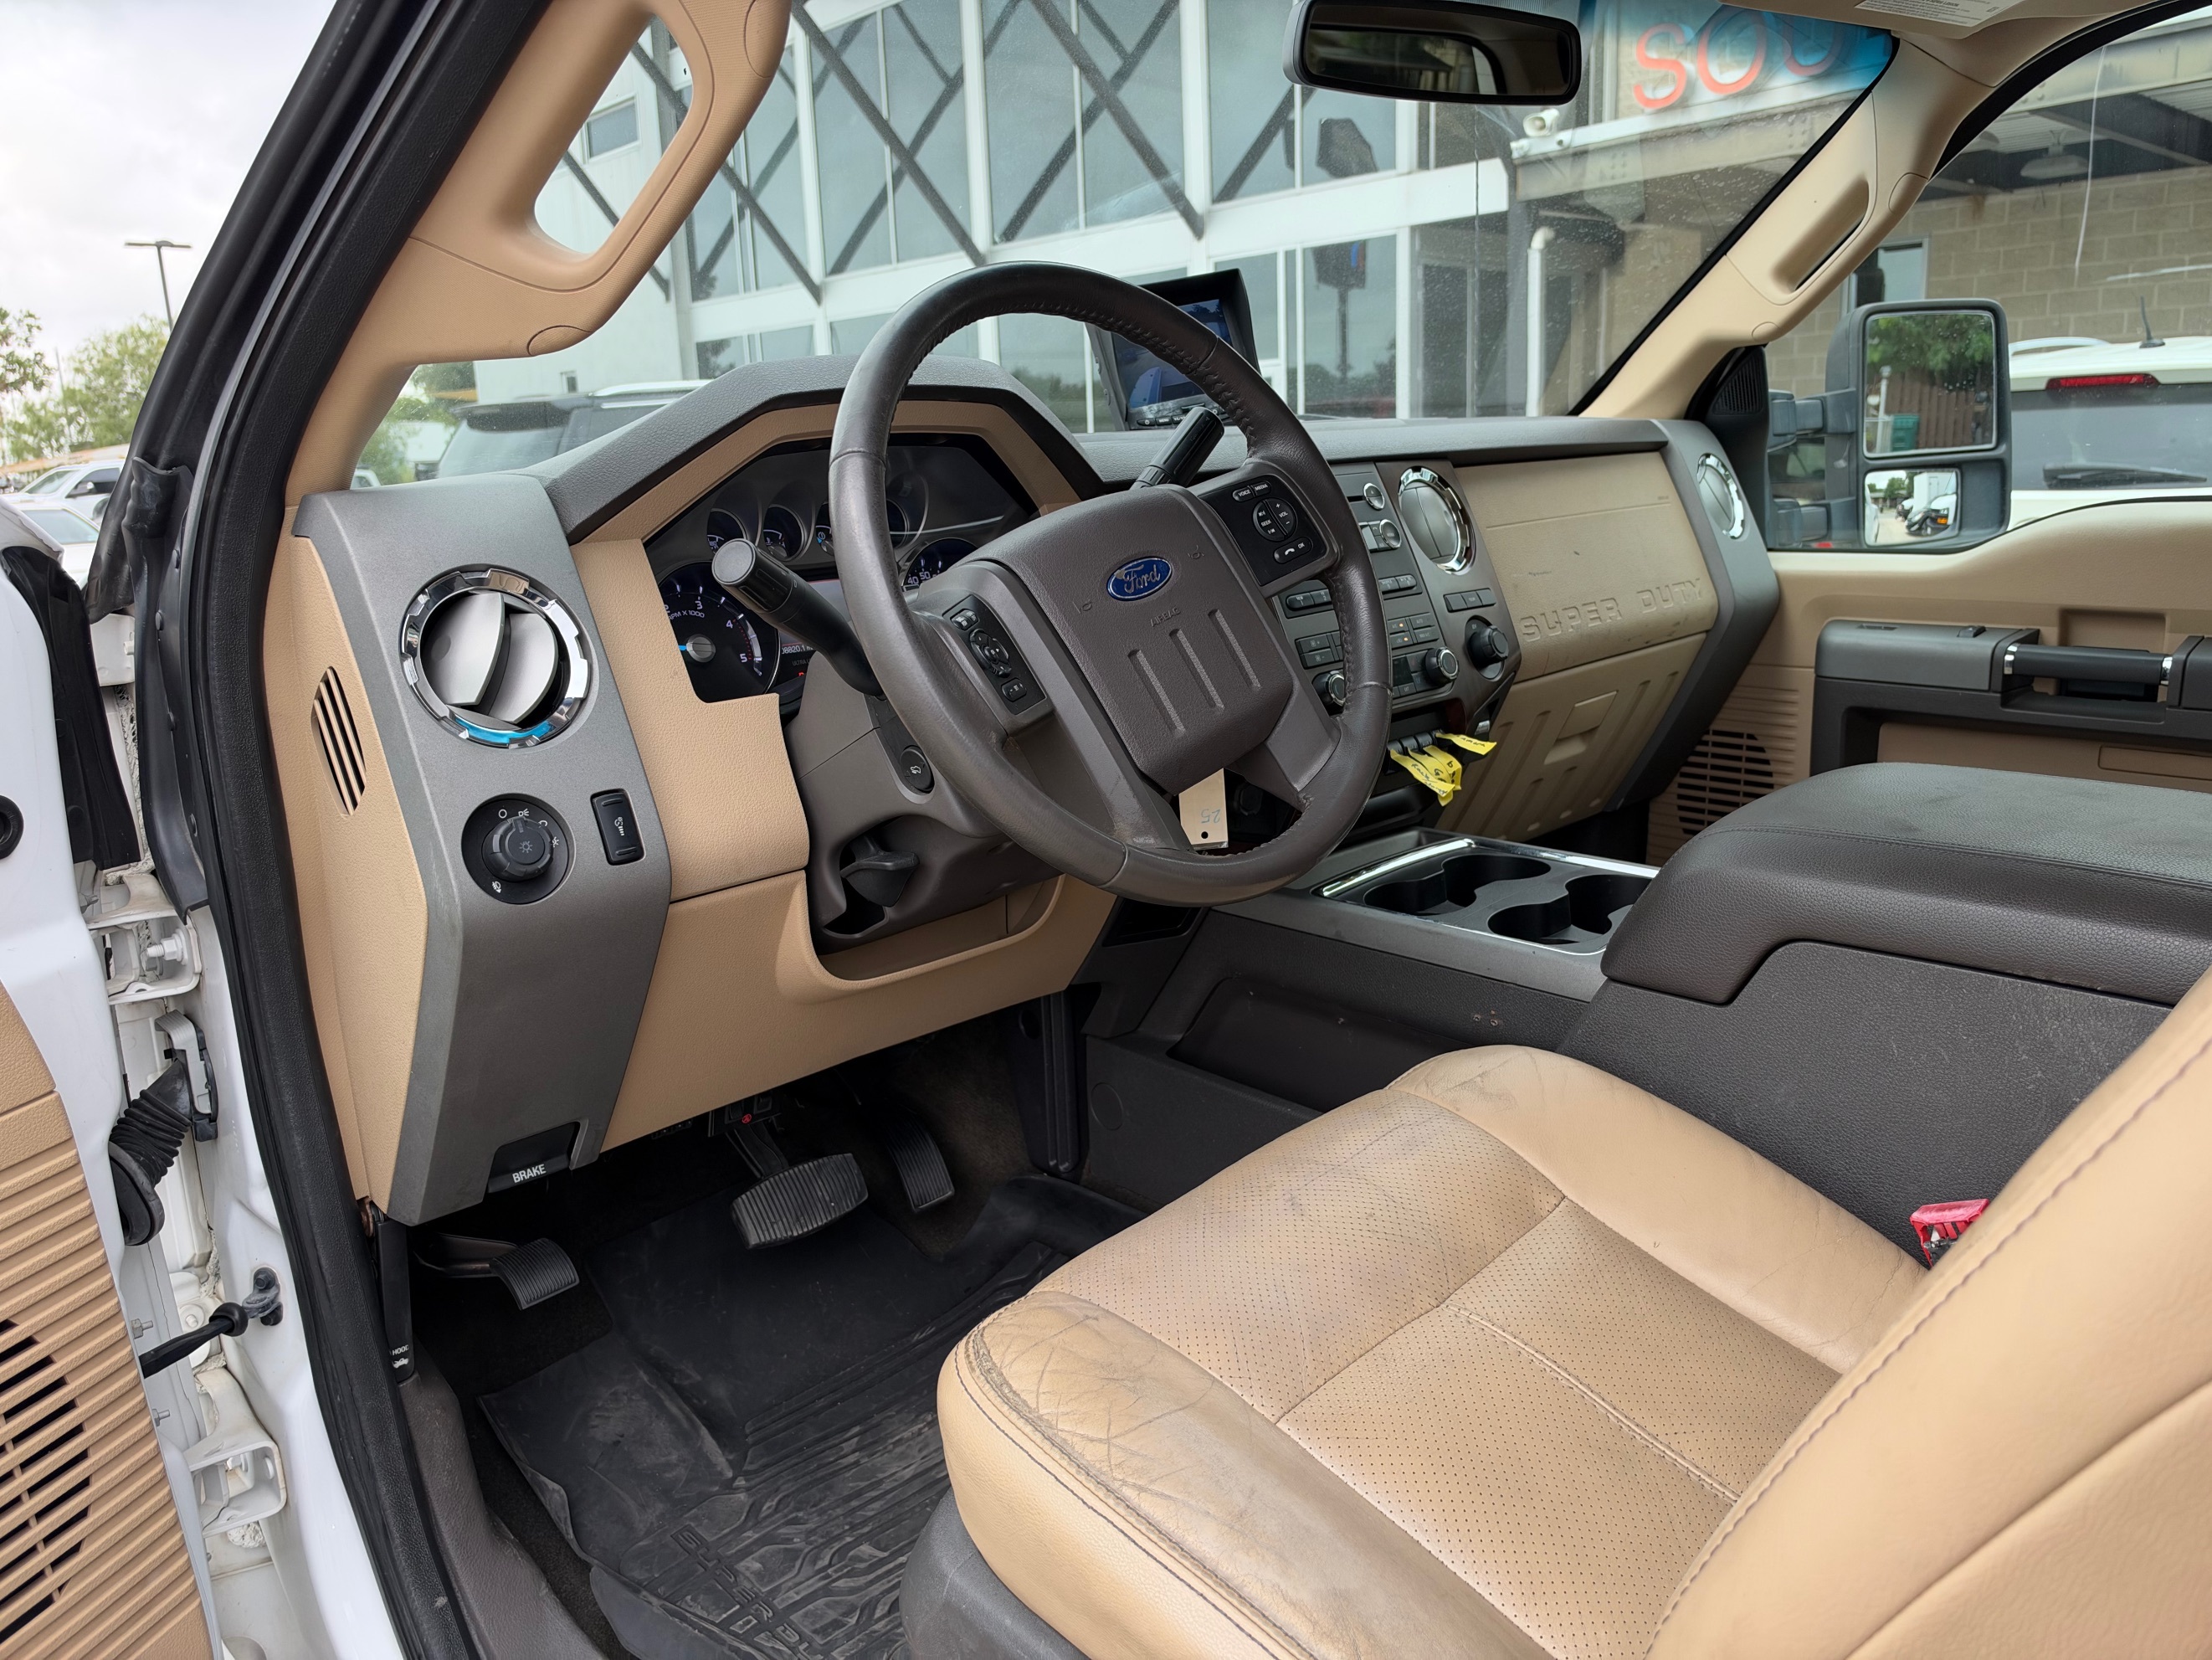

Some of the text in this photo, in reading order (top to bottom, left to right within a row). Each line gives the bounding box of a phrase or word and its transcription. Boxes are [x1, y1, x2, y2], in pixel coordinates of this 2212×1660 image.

[1254, 483, 1269, 491] MEDIA
[1238, 489, 1251, 497] VOICE
[919, 571, 931, 580] 50
[1111, 562, 1163, 594] Ford
[908, 577, 919, 585] 40
[695, 600, 703, 610] 3
[1519, 578, 1703, 642] SUPER DUTY
[689, 610, 705, 619] 1000
[1150, 607, 1181, 628] AIRBAG
[726, 619, 733, 629] 4
[740, 653, 748, 663] 5
[1200, 808, 1221, 825] 25
[511, 1164, 547, 1184] BRAKE
[675, 1527, 774, 1622] SUPER
